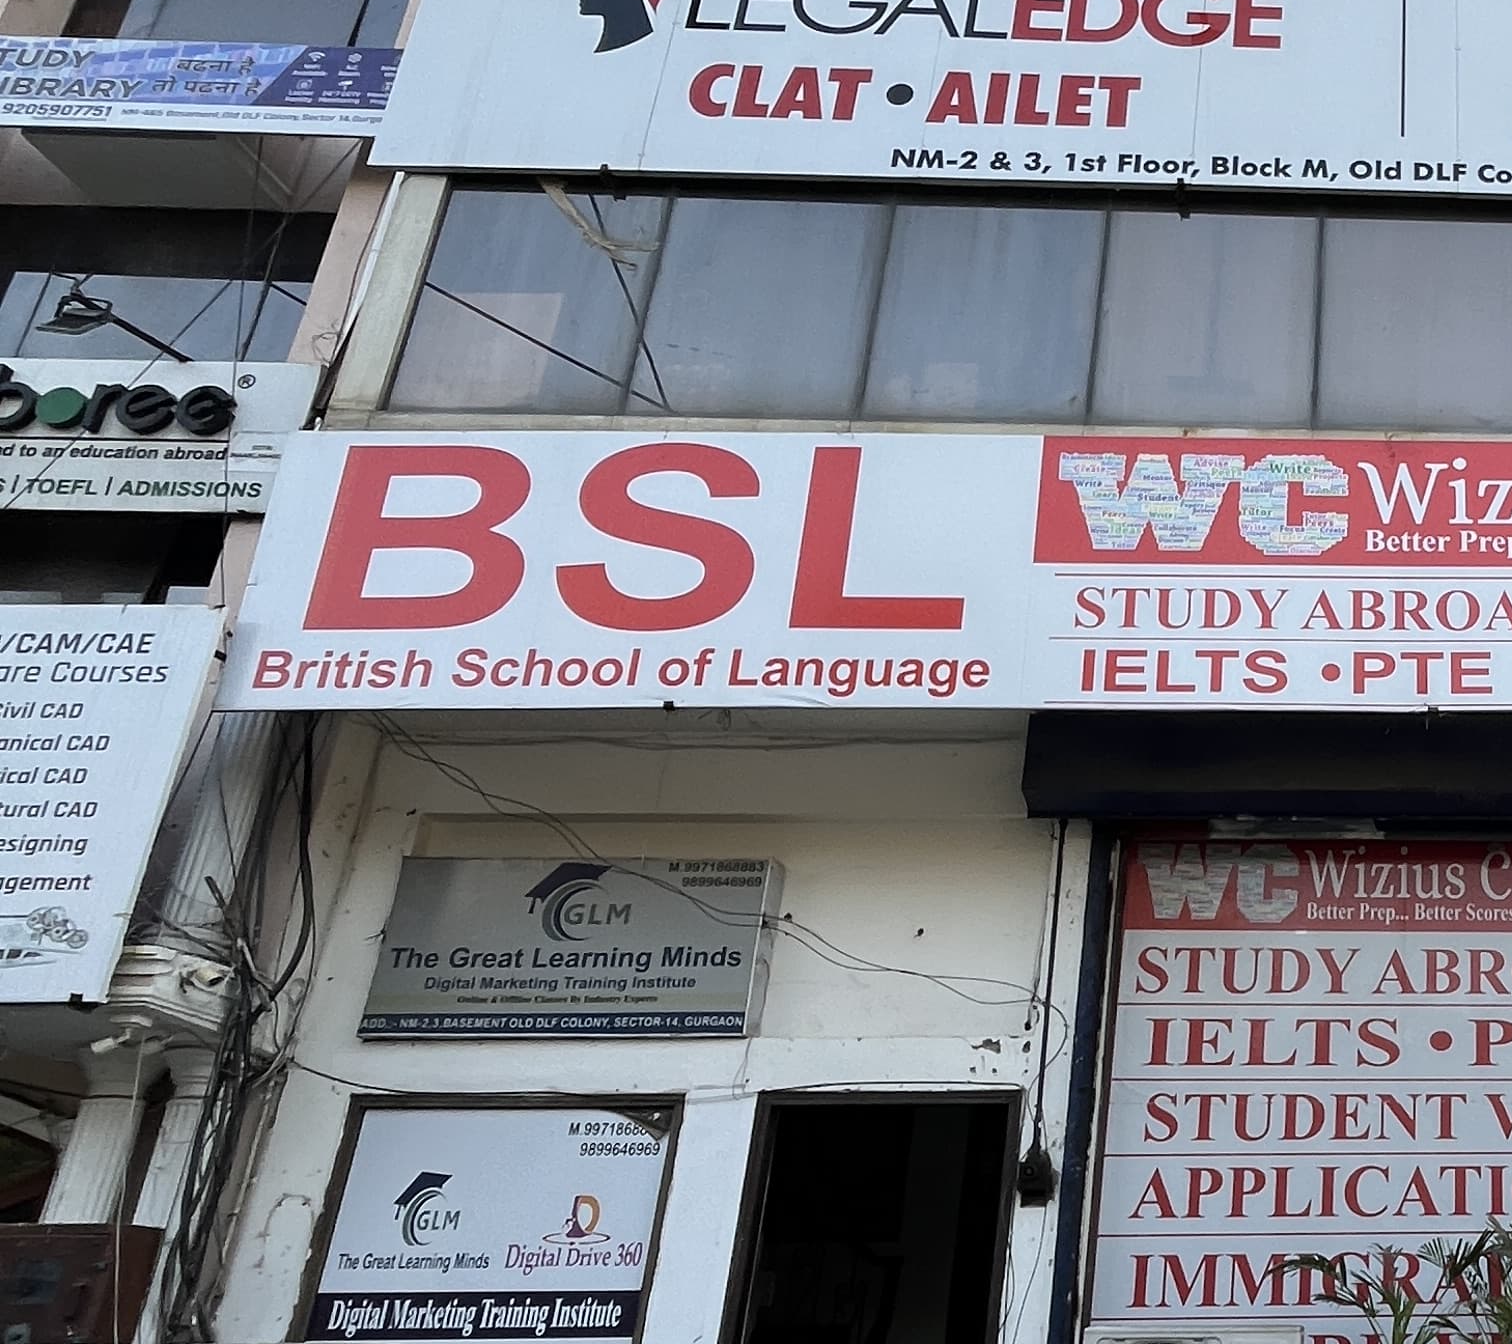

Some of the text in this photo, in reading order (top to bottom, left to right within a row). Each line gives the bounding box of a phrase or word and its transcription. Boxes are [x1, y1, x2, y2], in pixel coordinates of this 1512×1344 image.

[687, 63, 1142, 129] CLAT AILET
[890, 148, 979, 171] NM-2
[1064, 152, 1108, 173] 1st
[1117, 154, 1201, 179] Floor,
[1211, 156, 1292, 179] Block
[1348, 159, 1402, 182] Old
[1413, 162, 1468, 183] DLF
[70, 445, 159, 460] education
[163, 447, 229, 462] abroad
[117, 481, 263, 499] ADMISSIONS
[302, 441, 967, 633] BSL
[1365, 530, 1455, 555] Better
[1074, 587, 1289, 630] STUDY
[51, 661, 169, 683] Courses
[251, 647, 992, 698] British School of Language
[1082, 648, 1289, 694] IELTS
[1352, 650, 1494, 695] PTE
[564, 902, 632, 926] GLM
[391, 946, 743, 974] The Great Learning Minds
[1135, 946, 1362, 997] STUDY
[424, 975, 697, 993] Digital Marketing Training Institute
[1143, 1092, 1467, 1144] STUDENT
[579, 1141, 661, 1157] 9899646969
[505, 1241, 643, 1276] Digital Drive 360
[328, 1295, 623, 1338] Digital Marketing Training Institute
